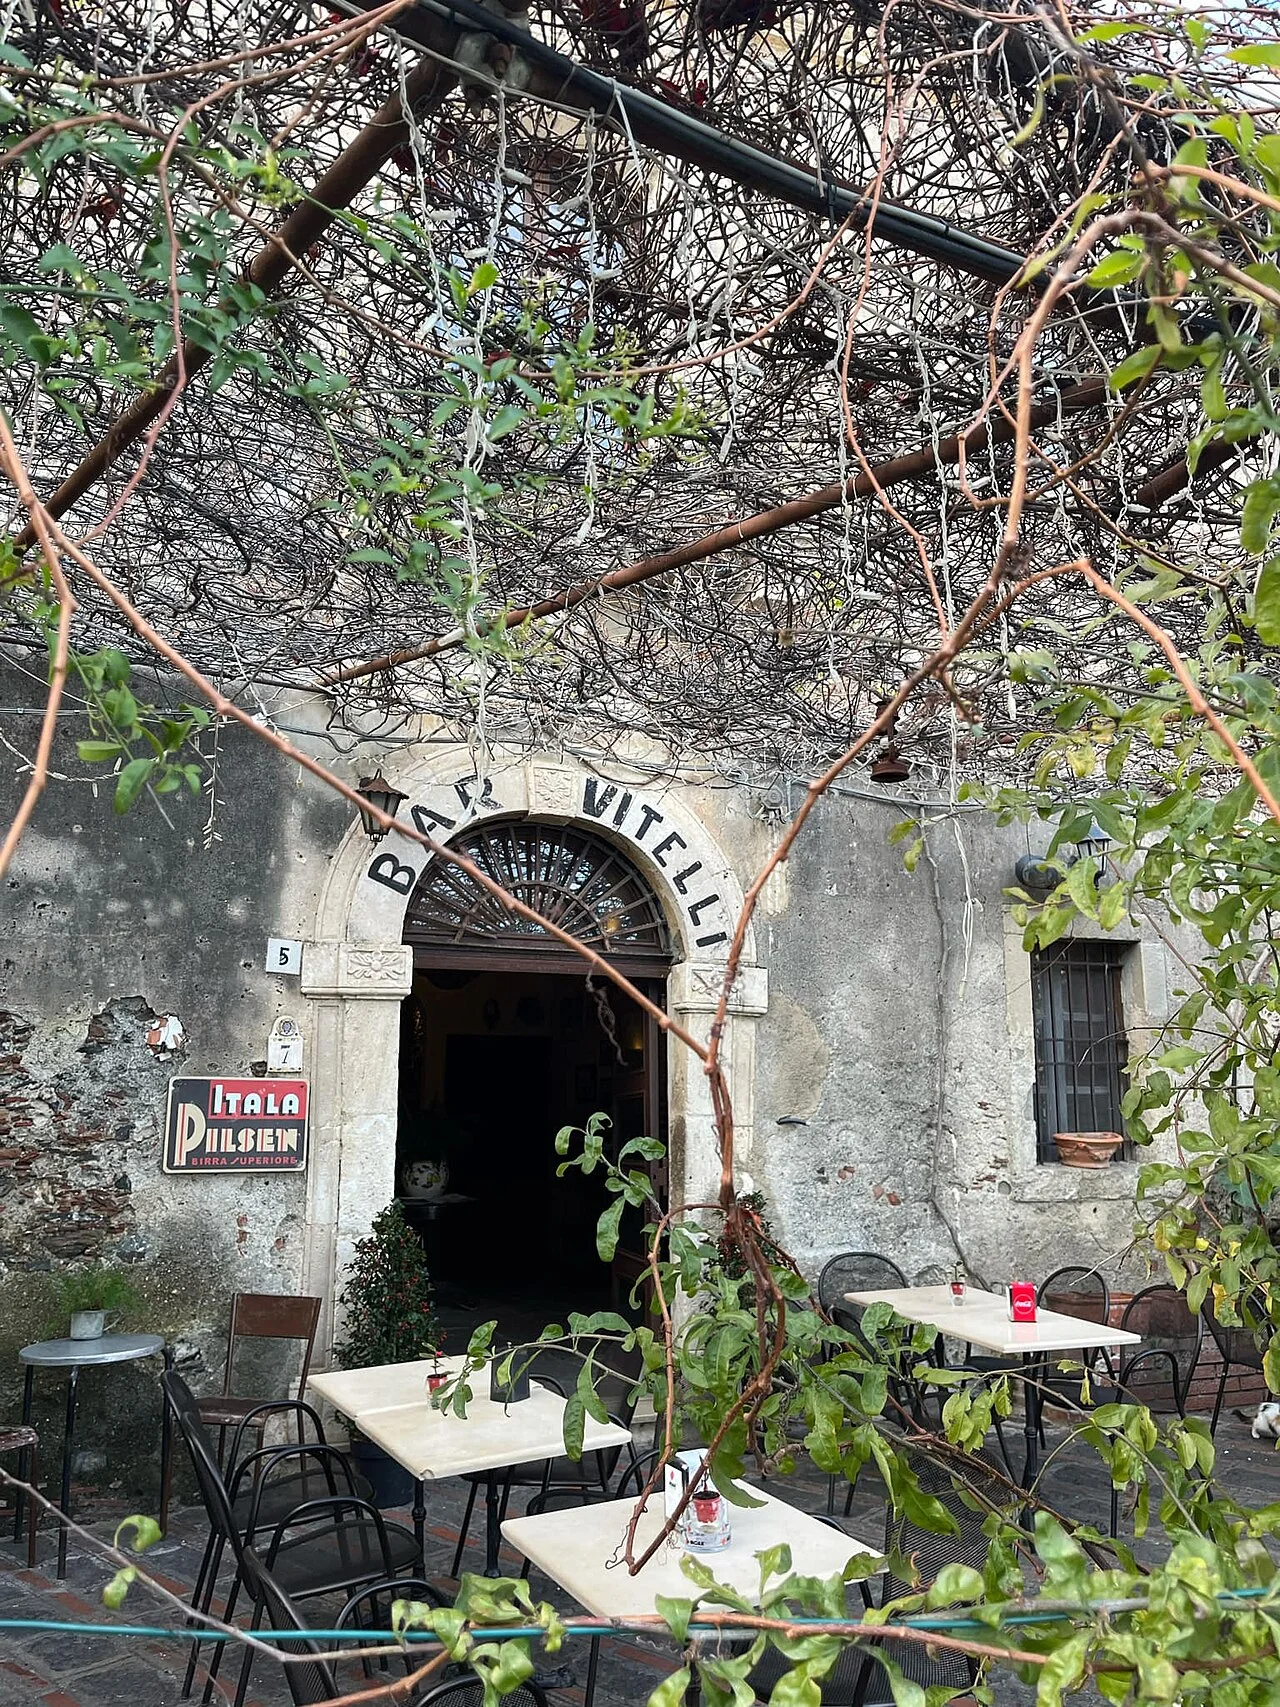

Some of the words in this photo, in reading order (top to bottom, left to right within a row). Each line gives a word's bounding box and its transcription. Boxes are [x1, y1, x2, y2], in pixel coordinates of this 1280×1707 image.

[368, 774, 504, 896] BAR
[582, 777, 727, 947] VITELLI
[279, 946, 290, 965] 5
[212, 1084, 300, 1116] ITALA
[173, 1103, 298, 1166] PILSEN
[191, 1157, 227, 1166] BIRRA
[231, 1156, 297, 1166] SUPERIORE
